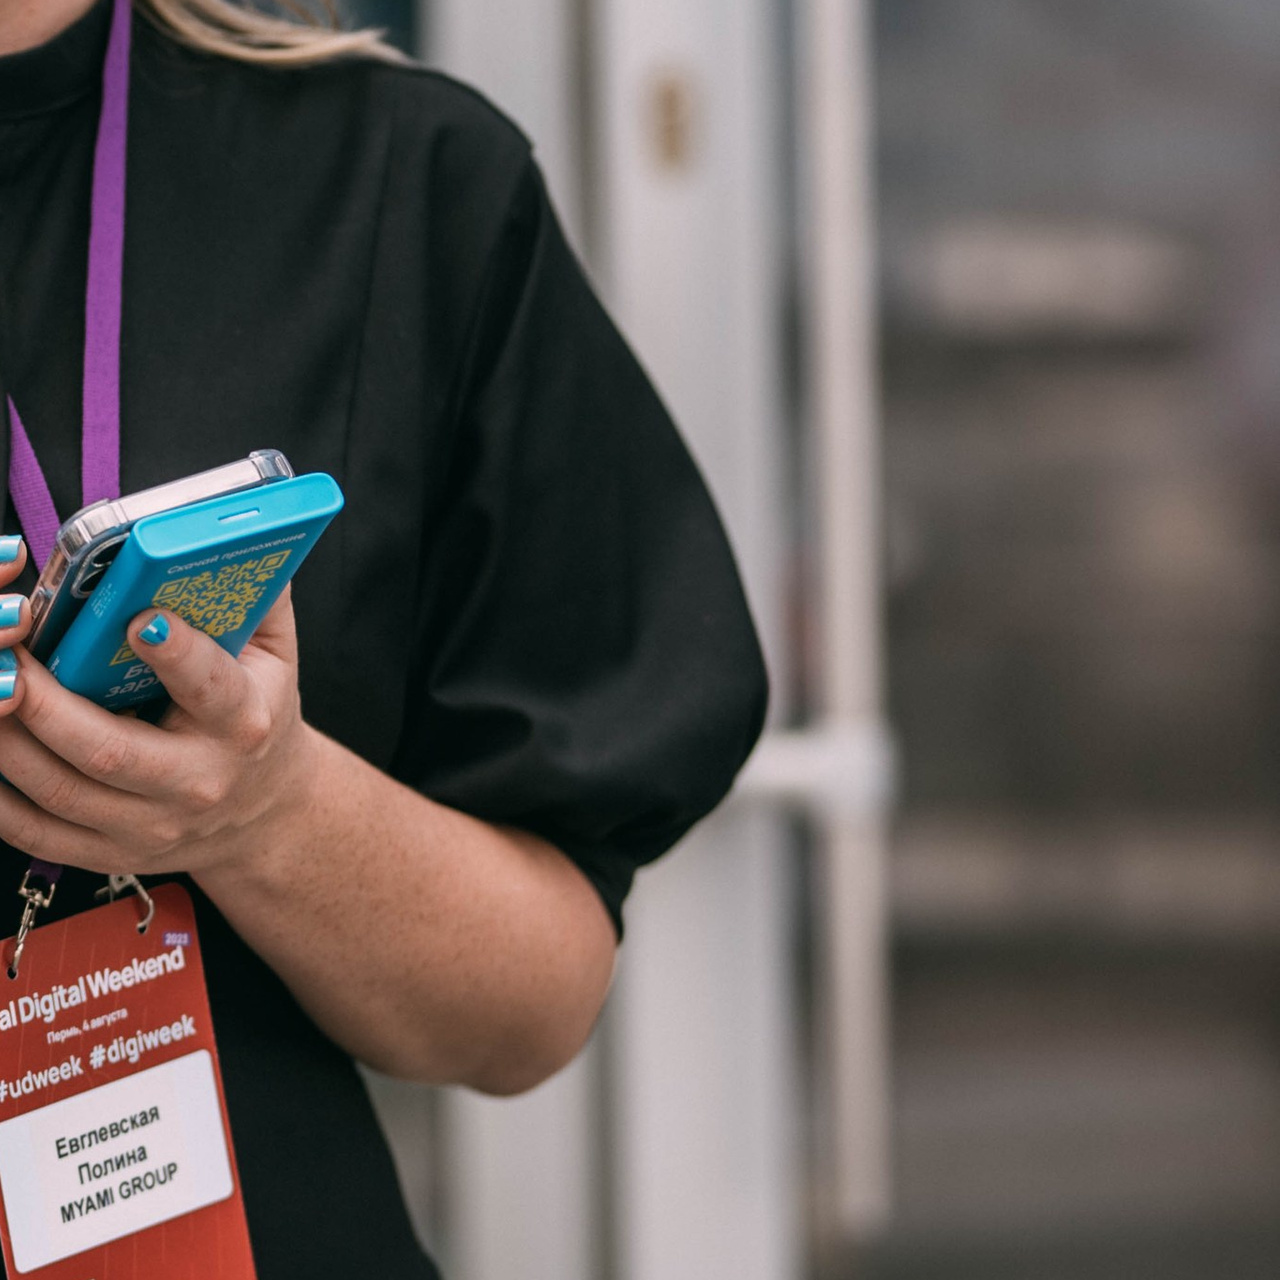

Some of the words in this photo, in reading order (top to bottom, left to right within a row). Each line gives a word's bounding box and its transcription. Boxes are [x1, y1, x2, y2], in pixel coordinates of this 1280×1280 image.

[167, 554, 219, 574] Скачай
[221, 532, 306, 560] приложение
[105, 676, 160, 698] зар
[18, 977, 86, 1023] Digital
[87, 945, 186, 998] Weekend
[47, 1024, 82, 1044] Пермь,
[82, 1020, 90, 1031] 4
[90, 1008, 128, 1030] августа
[89, 1014, 196, 1069] #digiweek
[55, 1106, 160, 1159] Евглевская
[78, 1145, 148, 1185] Полина
[60, 1187, 115, 1223] MYAMI
[118, 1162, 178, 1199] GROUP
